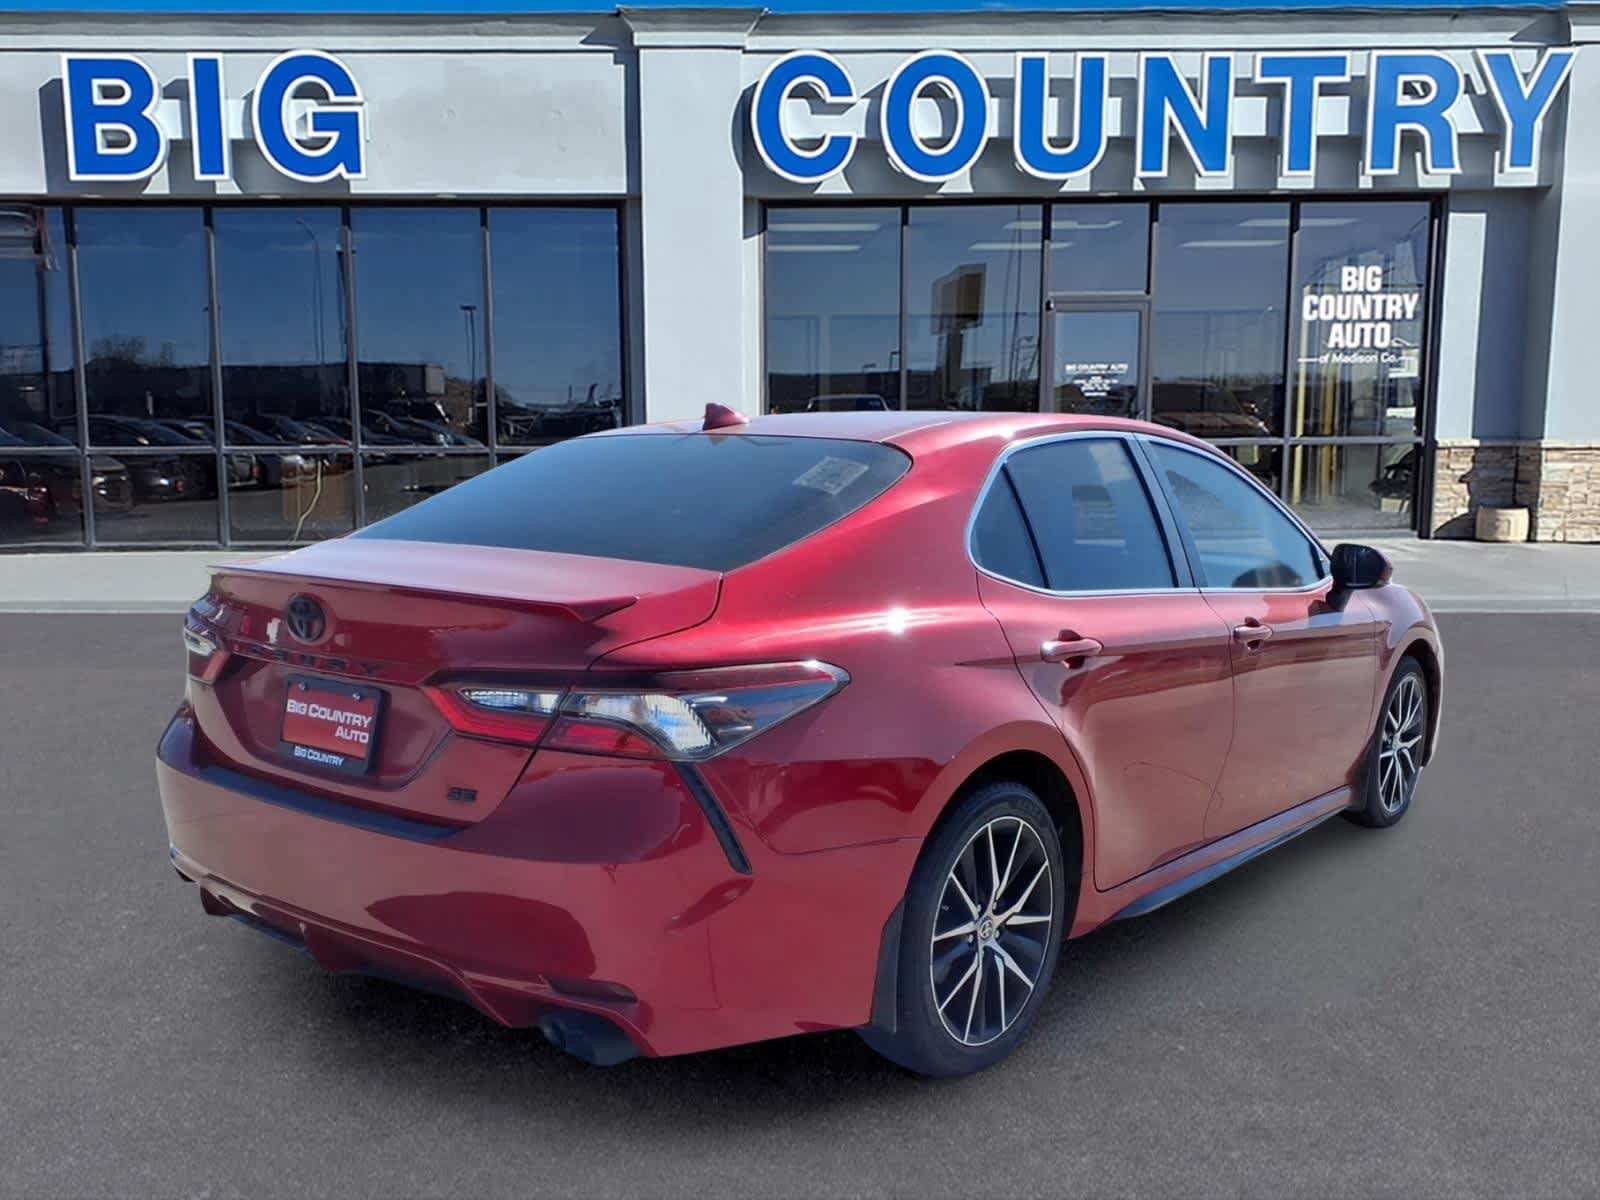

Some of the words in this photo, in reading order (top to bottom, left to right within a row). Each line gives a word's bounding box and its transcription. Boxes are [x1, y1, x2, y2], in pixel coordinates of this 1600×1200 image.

[61, 49, 368, 182] BIG
[751, 48, 1576, 184] COUNTRY
[1341, 265, 1382, 292] BIG
[1303, 293, 1419, 320] COUNTRY
[1327, 322, 1391, 348] AUTO
[1319, 353, 1329, 363] of
[1331, 353, 1378, 363] Madison
[287, 699, 307, 715] BIG
[308, 703, 372, 728] COUNTRY
[335, 725, 369, 744] AUTO
[294, 745, 307, 758] BIG
[307, 749, 344, 766] COUNTRY
